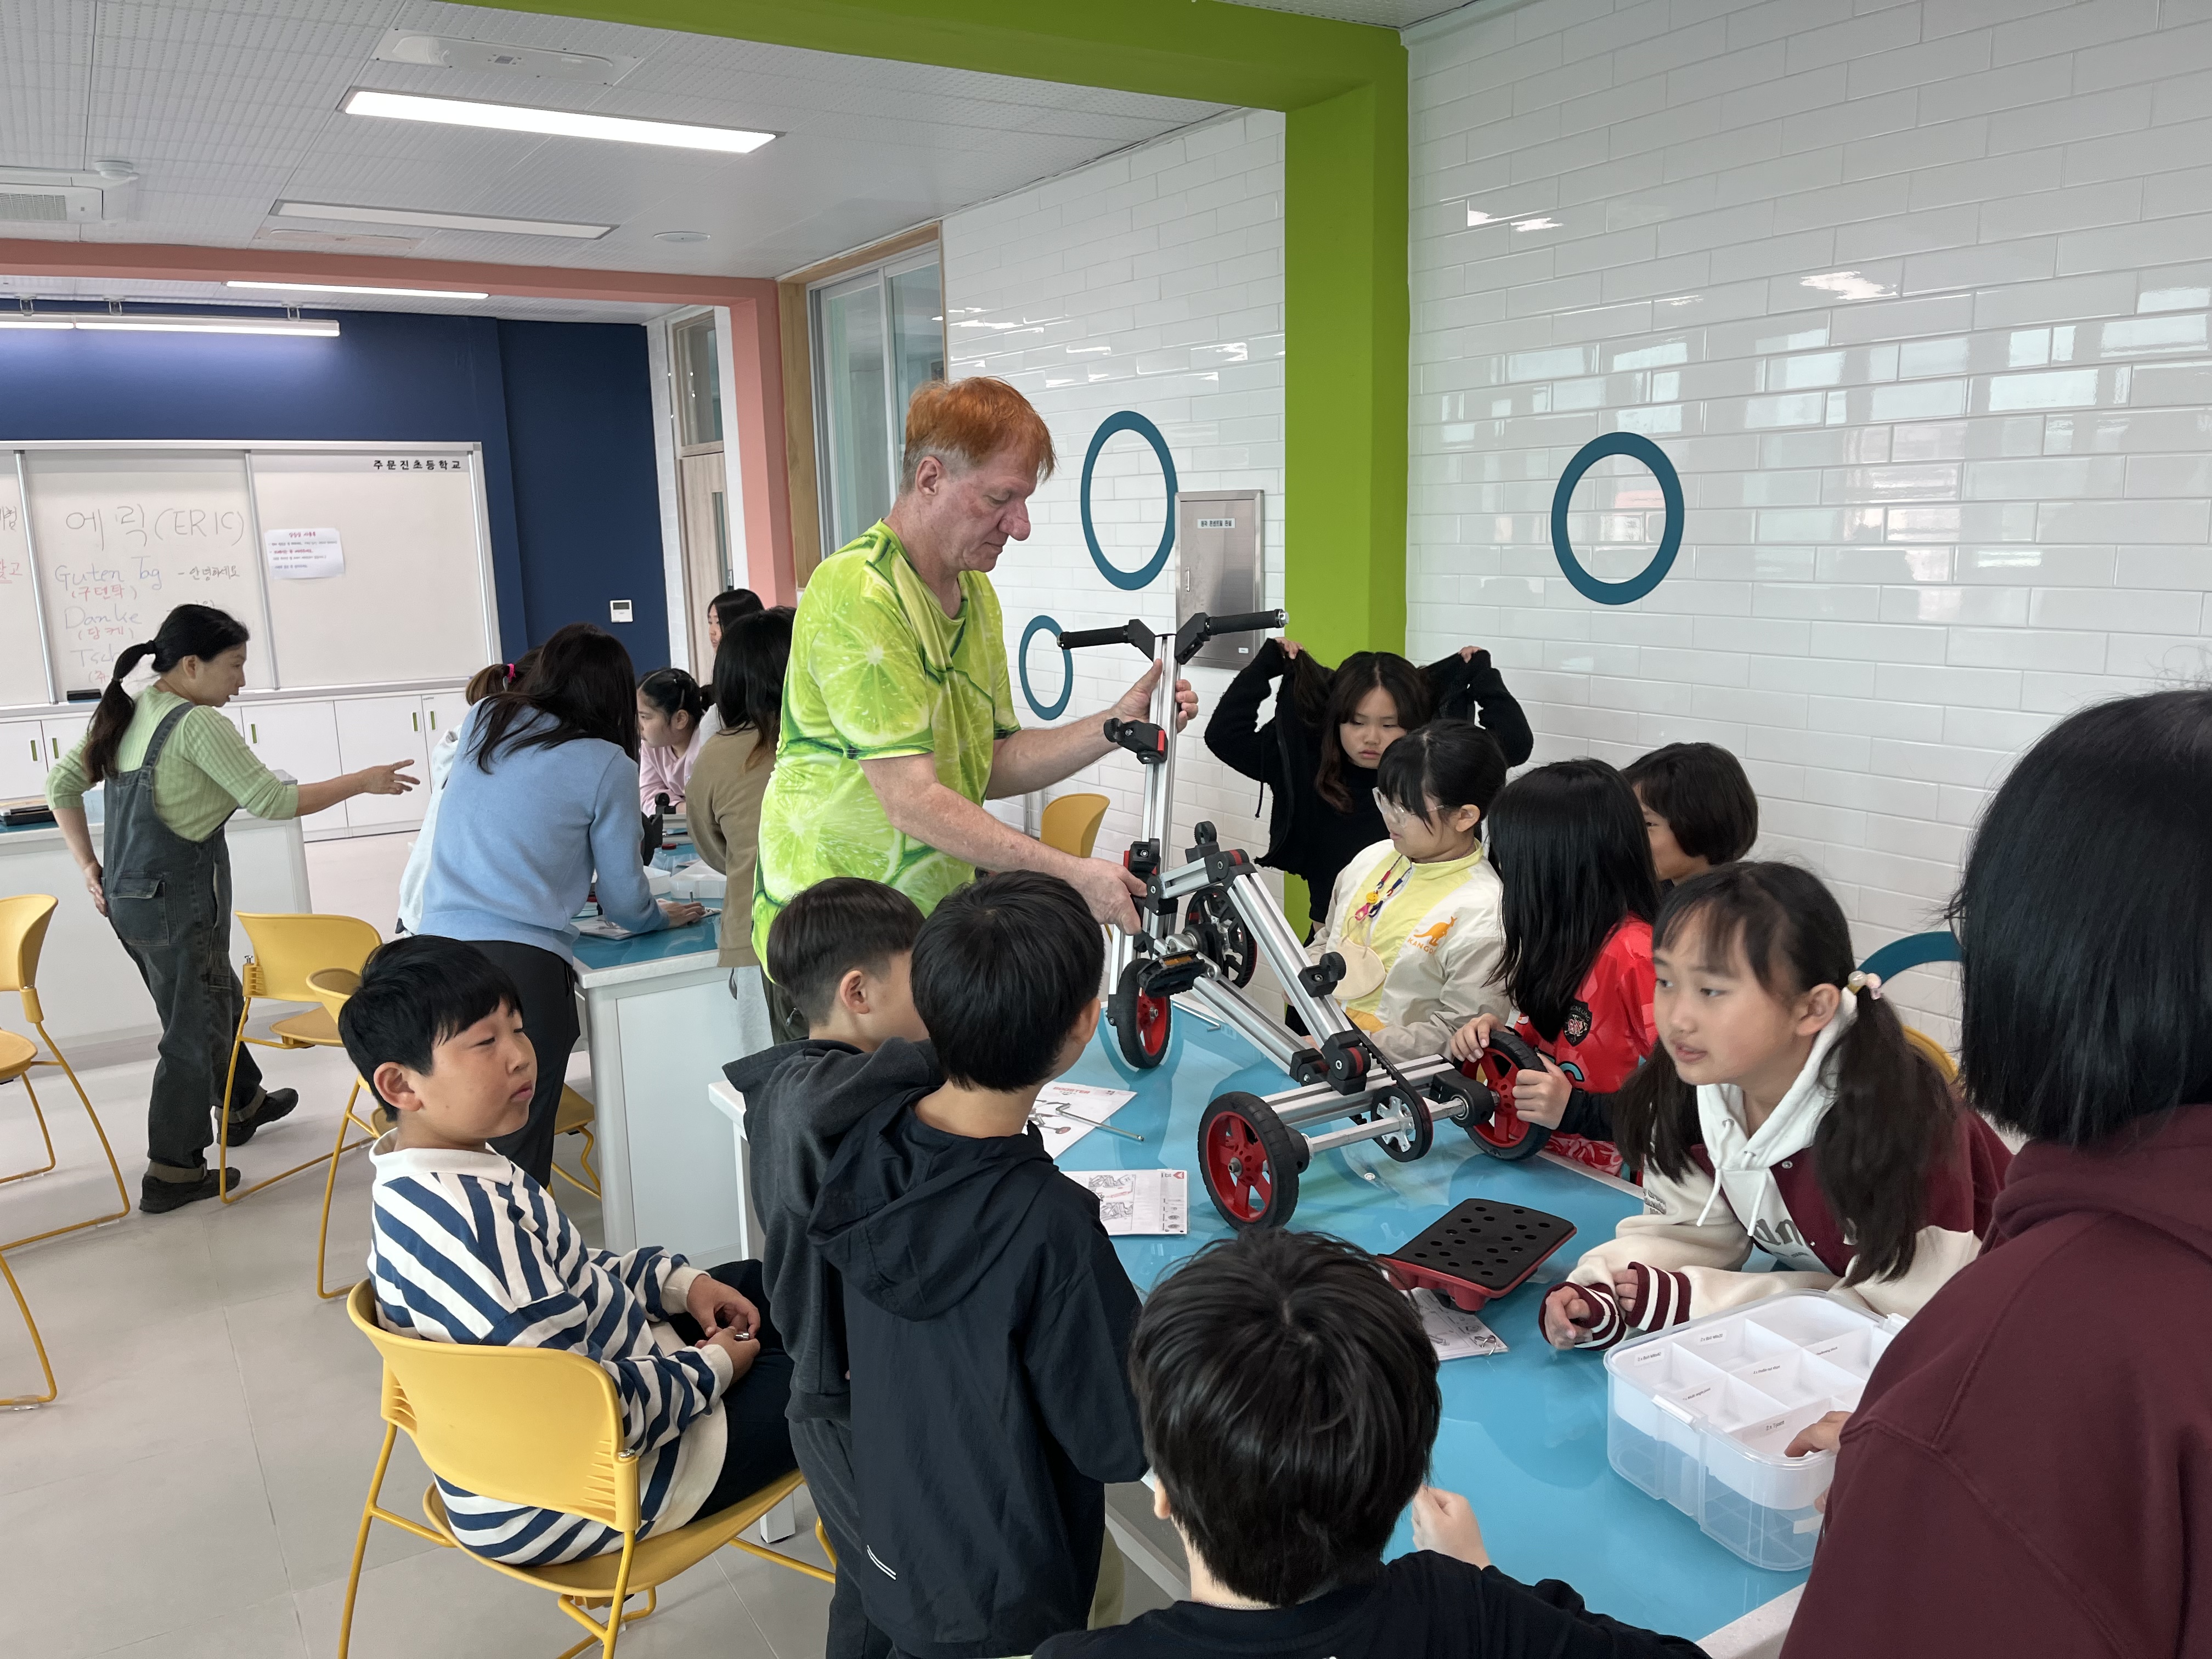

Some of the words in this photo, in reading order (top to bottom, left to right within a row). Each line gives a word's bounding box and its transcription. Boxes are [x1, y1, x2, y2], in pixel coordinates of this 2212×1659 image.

[374, 460, 461, 470] 주문진초등학교
[55, 563, 125, 590] Guten
[64, 603, 142, 629] Danke
[70, 643, 120, 667] Tsch
[1407, 938, 1437, 954] KANGO
